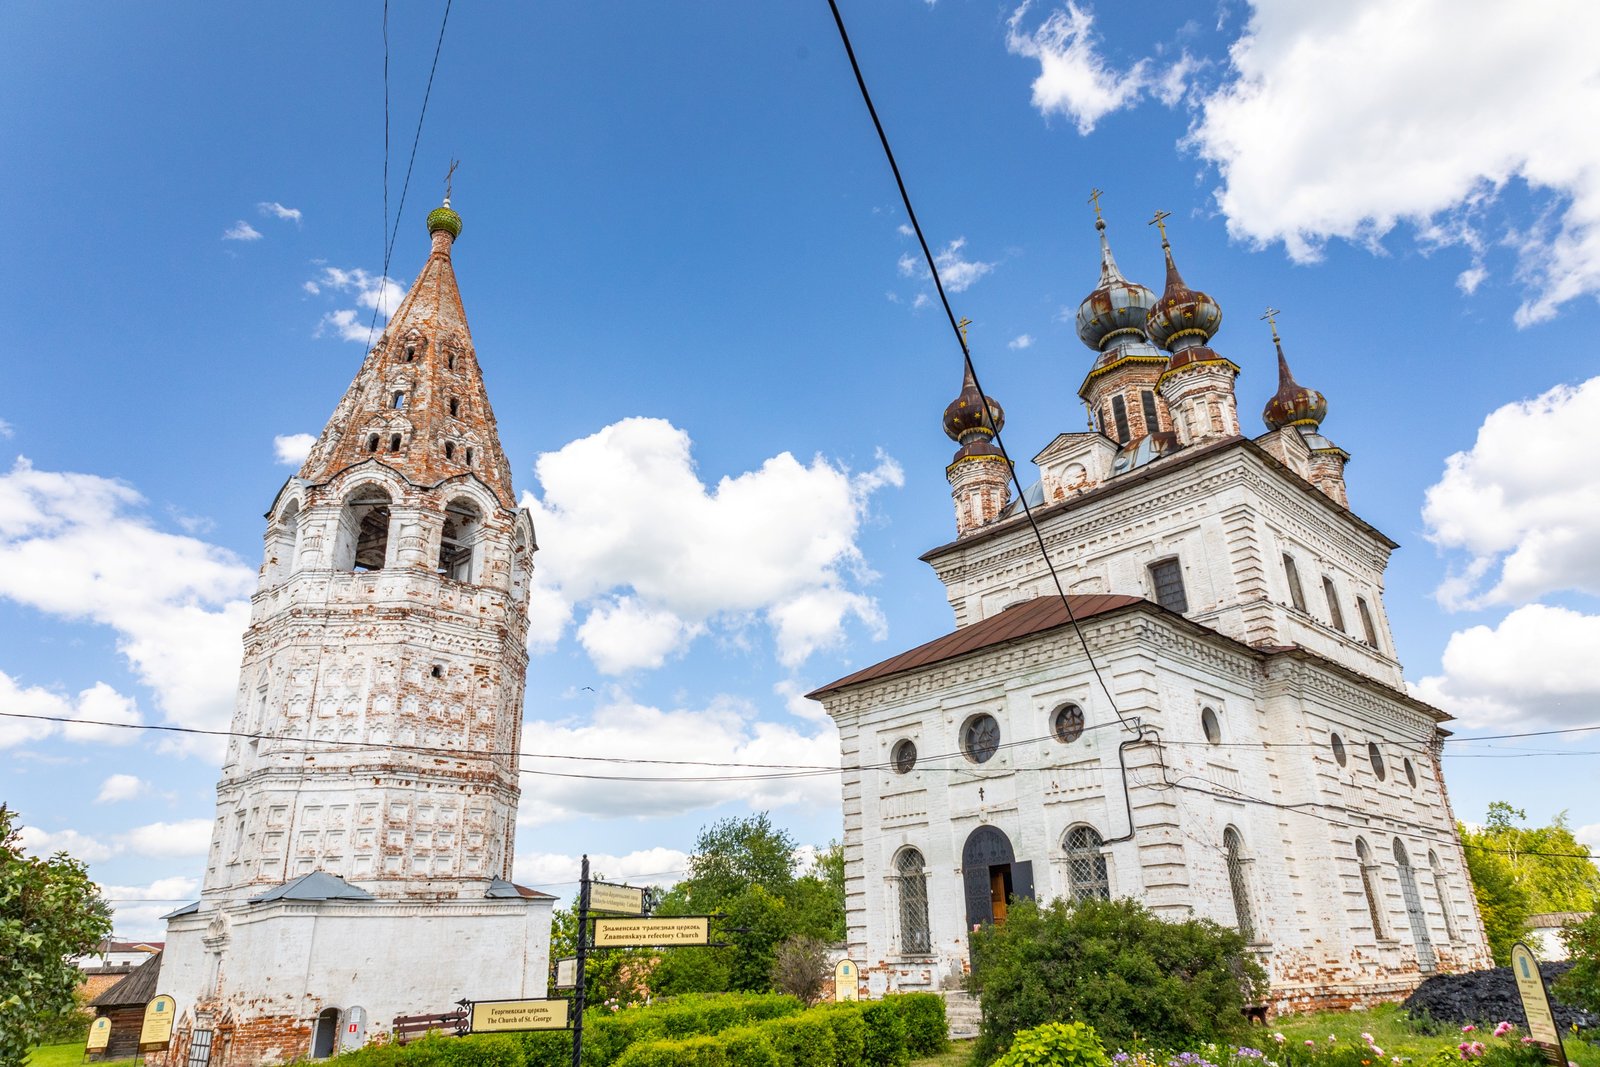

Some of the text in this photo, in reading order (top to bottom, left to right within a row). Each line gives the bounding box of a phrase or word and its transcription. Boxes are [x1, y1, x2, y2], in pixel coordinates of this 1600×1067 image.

[604, 933, 646, 941] Znamenskaya
[491, 1008, 526, 1016] Георгиевская
[533, 1015, 552, 1023] George
